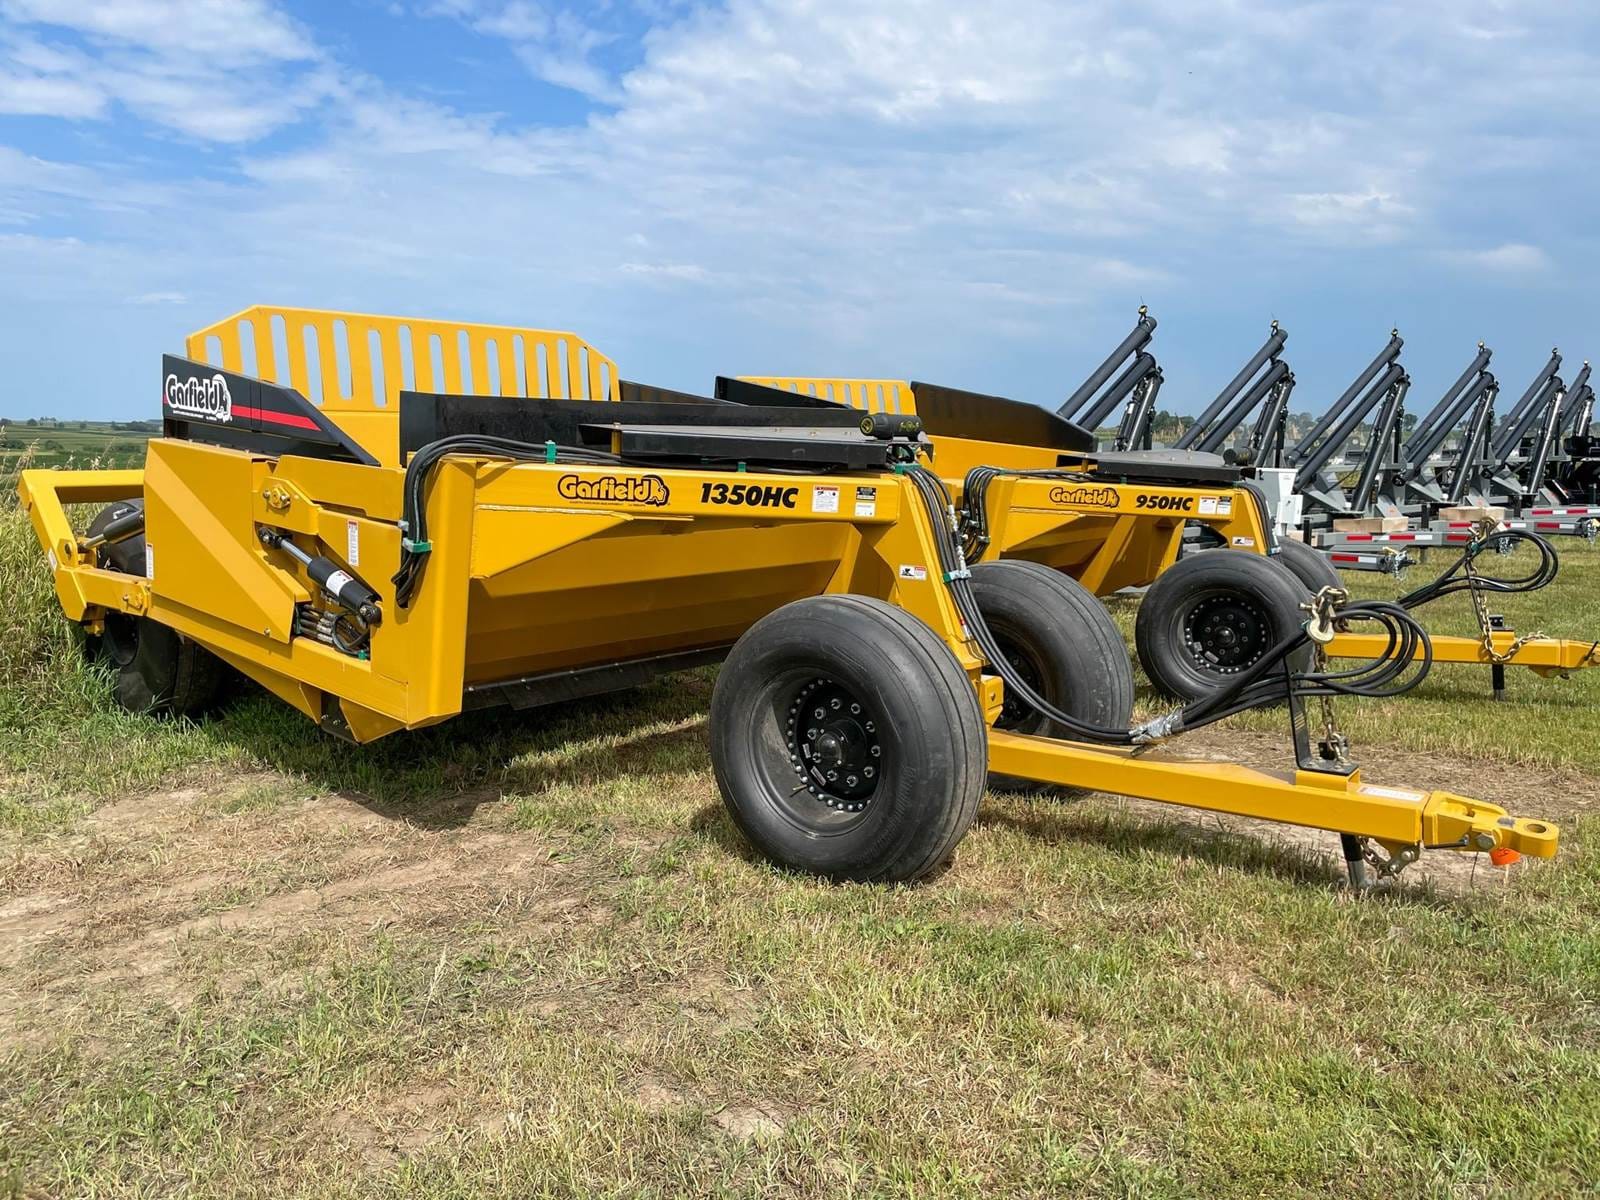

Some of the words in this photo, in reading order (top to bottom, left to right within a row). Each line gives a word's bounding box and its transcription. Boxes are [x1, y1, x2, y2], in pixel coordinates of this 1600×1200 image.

[166, 374, 220, 414] Garfield
[558, 474, 652, 502] Garfield
[701, 483, 799, 509] 1350HC
[1049, 487, 1109, 505] Garfield
[1136, 494, 1194, 511] 950HC
